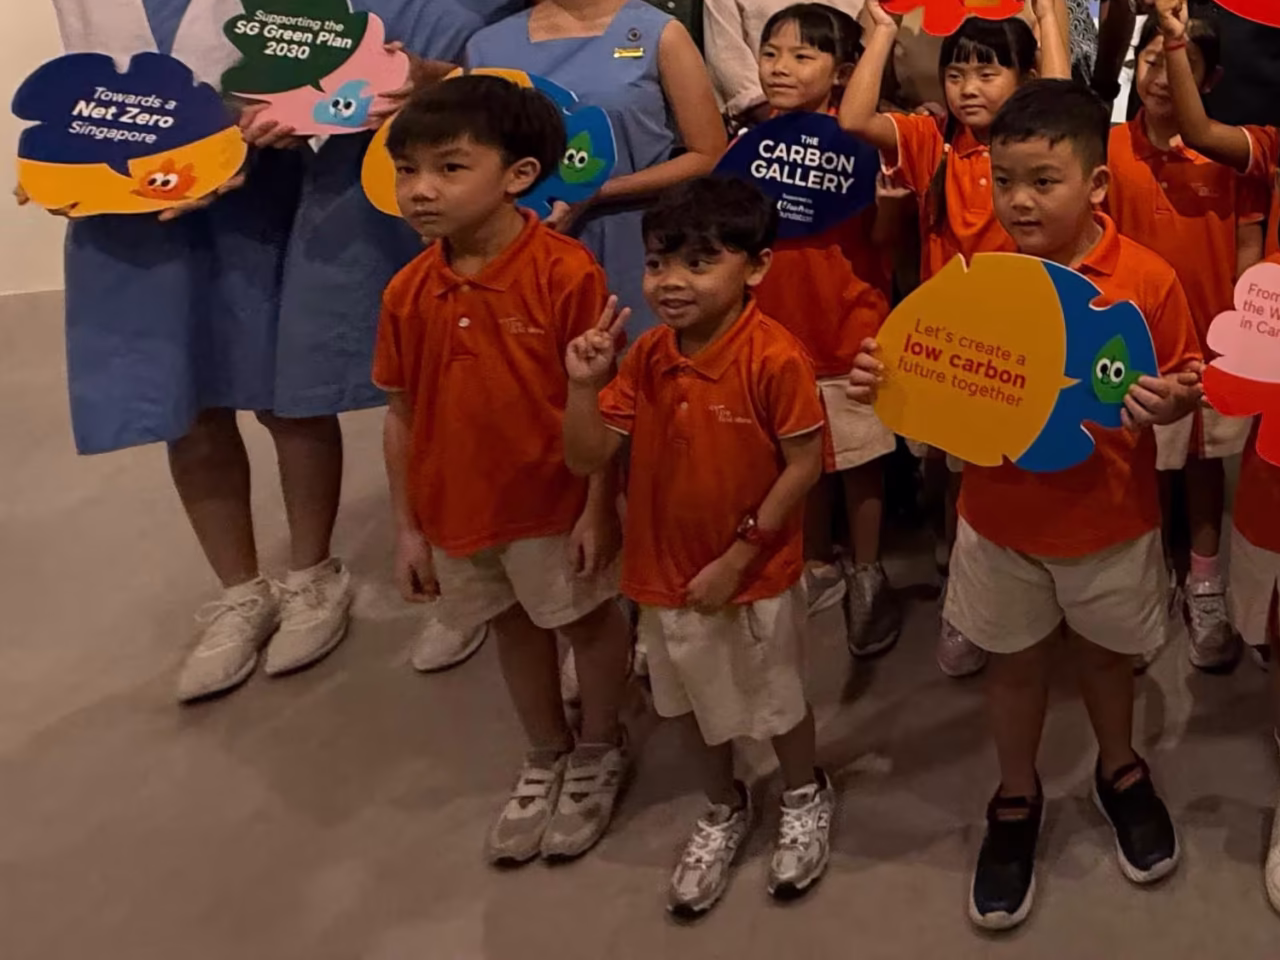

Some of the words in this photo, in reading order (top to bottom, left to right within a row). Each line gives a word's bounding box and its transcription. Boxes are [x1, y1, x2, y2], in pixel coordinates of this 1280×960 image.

[254, 10, 322, 31] Supporting
[324, 20, 345, 32] the
[233, 20, 260, 35] SG
[263, 24, 313, 43] Green
[316, 31, 353, 49] Plan
[263, 41, 310, 60] 2030
[93, 86, 163, 108] Towards
[164, 100, 178, 110] a
[71, 100, 117, 120] Net
[118, 107, 175, 128] Zero
[68, 120, 158, 144] Singapore
[800, 134, 819, 146] THE
[758, 139, 855, 174] CARBON
[750, 160, 855, 194] GALLERY
[1243, 300, 1264, 316] the
[1240, 316, 1253, 331] in
[915, 318, 954, 343] Let's
[958, 336, 1012, 361] create
[1016, 354, 1026, 367] a
[904, 333, 943, 362] low
[949, 353, 1027, 389] carbon
[898, 355, 946, 383] future
[951, 374, 1024, 408] together
